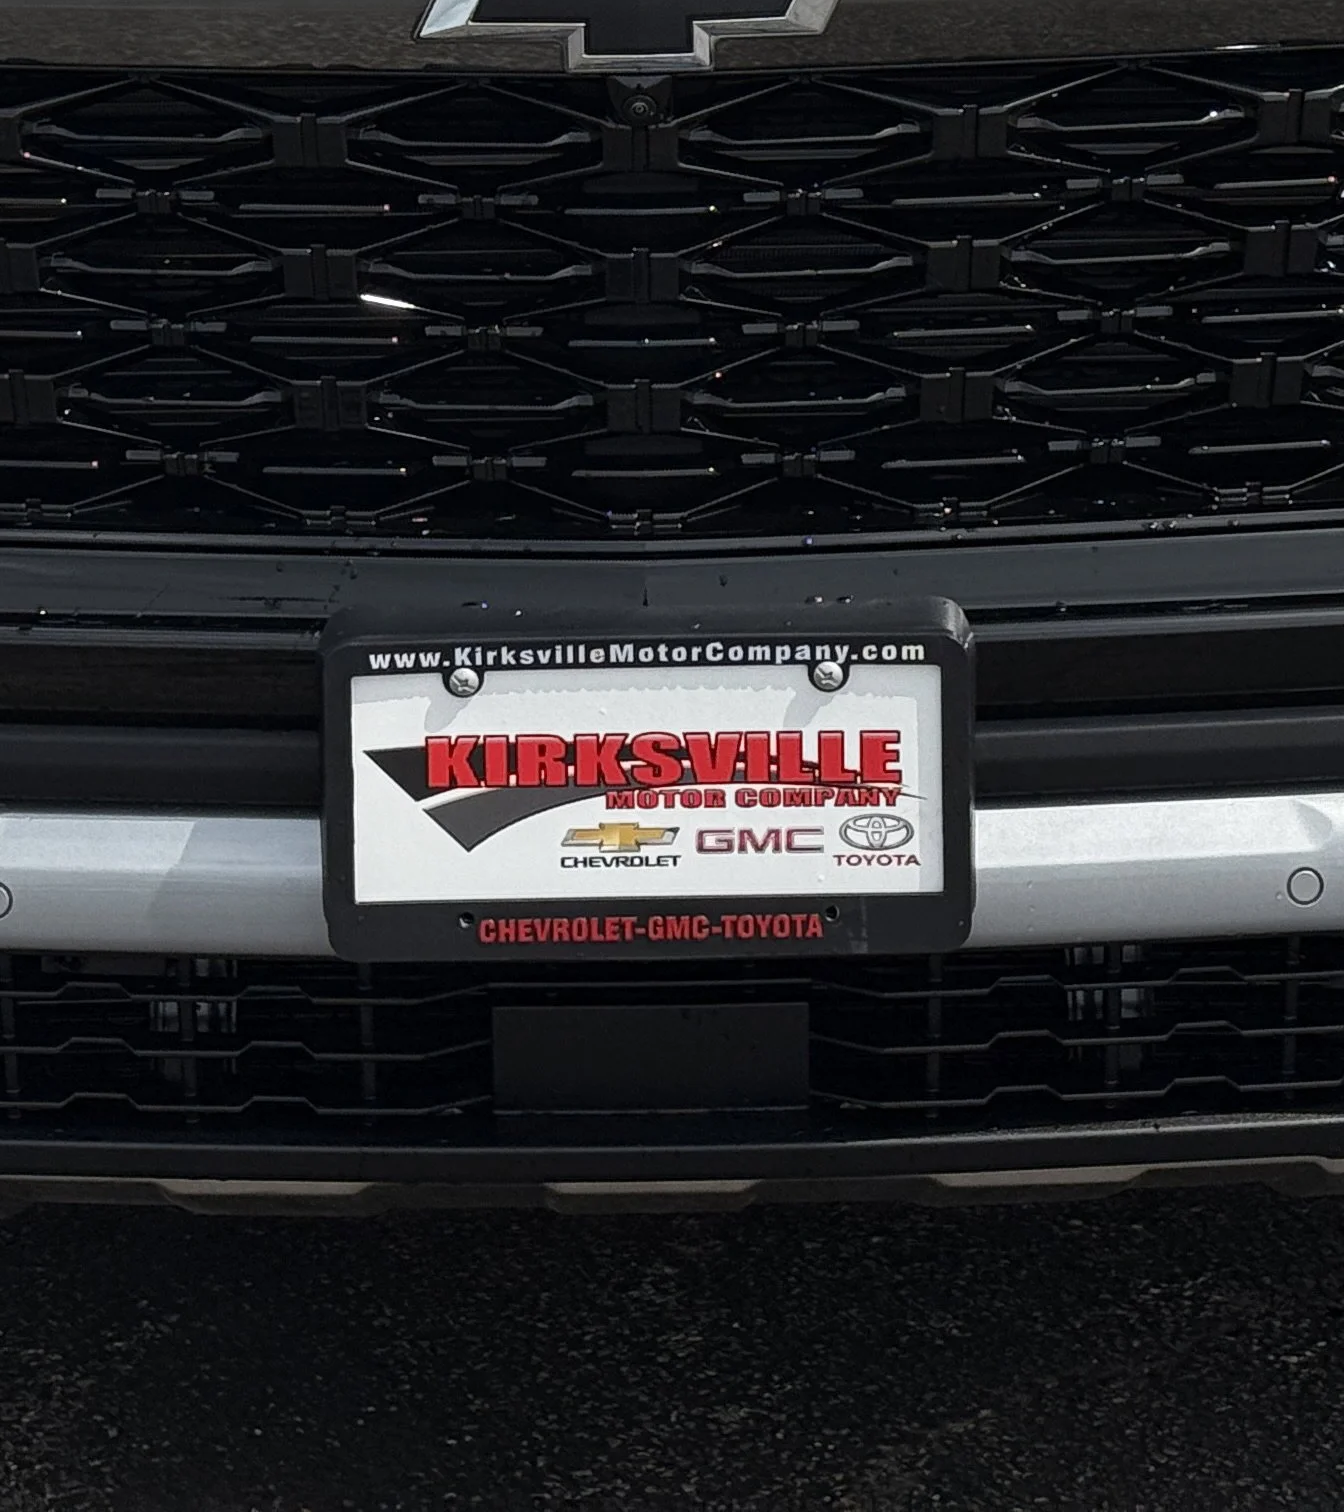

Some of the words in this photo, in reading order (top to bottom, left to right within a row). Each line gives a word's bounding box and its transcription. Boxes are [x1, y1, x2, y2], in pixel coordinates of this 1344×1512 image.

[369, 642, 925, 670] www.KirksvilleMotorCompany.com
[423, 730, 903, 788] KIRKSVILLE
[606, 788, 727, 809] MOTOR
[734, 788, 901, 807] COMPANY
[695, 826, 825, 854] GMC
[560, 854, 682, 869] CHEVROLET
[832, 854, 921, 867] TOYOTA
[479, 913, 824, 943] CHEVROLET-GMC-TOYOTA
